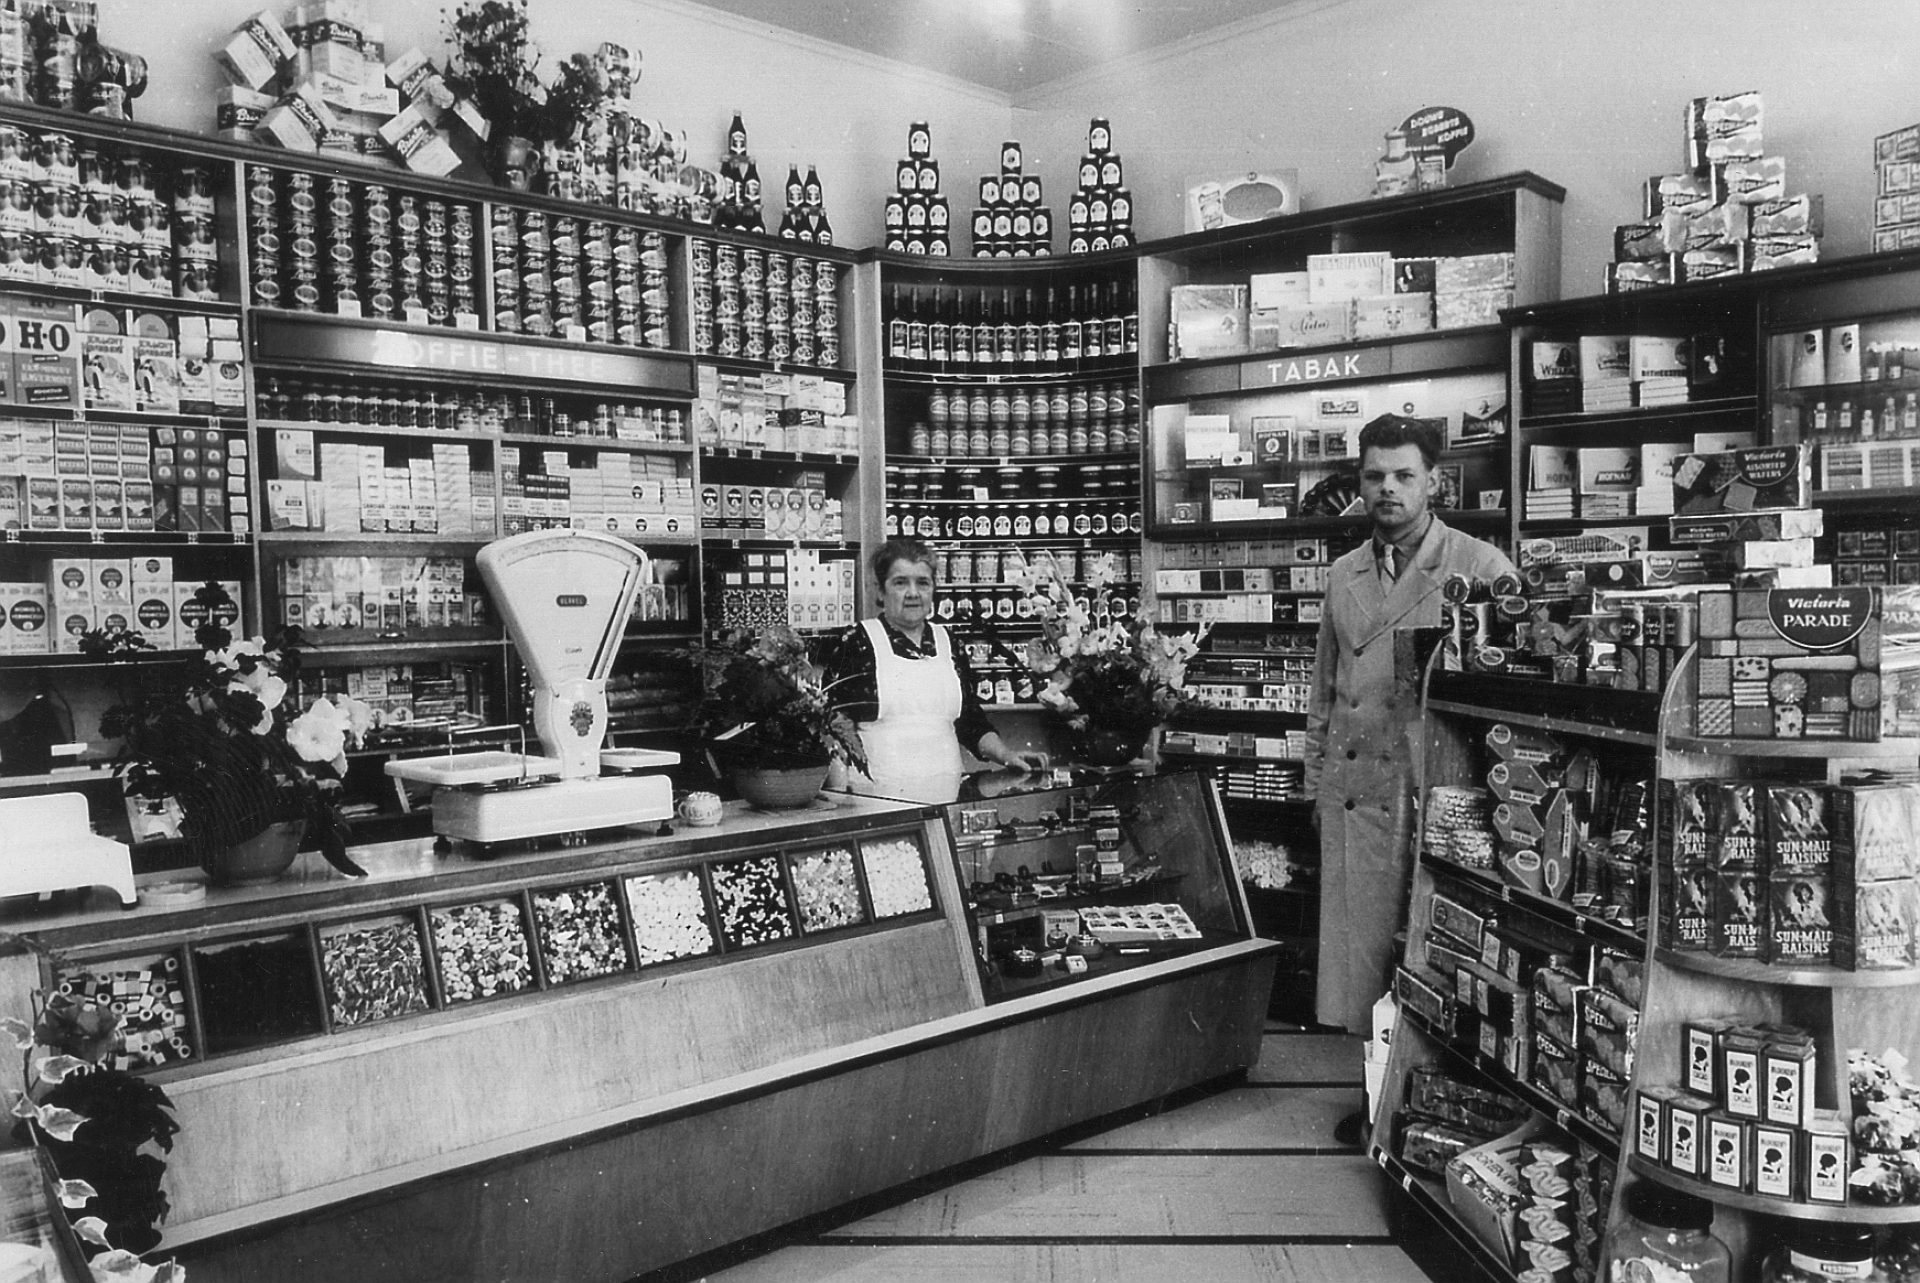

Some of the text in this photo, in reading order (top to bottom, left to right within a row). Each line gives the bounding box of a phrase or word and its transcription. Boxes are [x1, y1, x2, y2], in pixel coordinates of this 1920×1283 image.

[529, 350, 606, 378] THEE
[1268, 354, 1361, 383] TABAK
[1744, 450, 1786, 461] Victoria
[1746, 462, 1787, 471] ASSORTED
[1788, 594, 1851, 609] Victoria
[1783, 614, 1852, 627] PARADE
[1783, 851, 1829, 864] RAISINS
[1776, 931, 1833, 942] SUN-MAID
[1782, 941, 1829, 953] RAISINS
